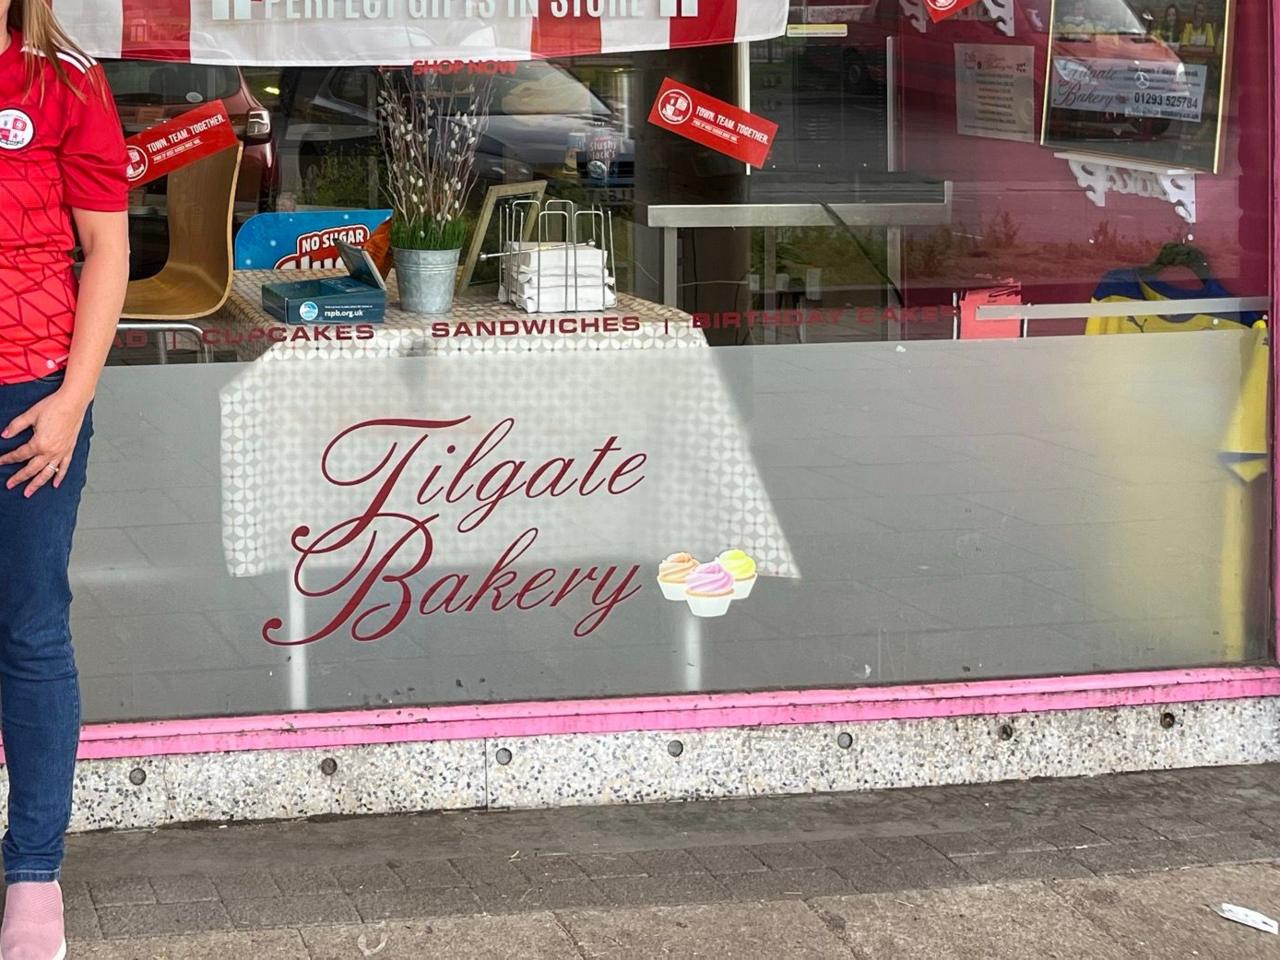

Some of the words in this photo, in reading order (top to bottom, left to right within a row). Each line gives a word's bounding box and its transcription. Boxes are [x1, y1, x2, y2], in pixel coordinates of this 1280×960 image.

[413, 60, 464, 76] SHOP
[468, 60, 517, 75] NOW
[1134, 93, 1163, 106] 01293
[1165, 95, 1198, 110] 525784
[168, 129, 191, 144] TEAM.
[302, 237, 319, 253] NO
[324, 309, 364, 318] rspb.org.uk
[202, 324, 375, 345] CUPCAKES
[431, 316, 640, 339] SANDWICHES
[692, 309, 844, 328] BIRTHDAY
[856, 305, 958, 323] CAKES
[291, 415, 647, 553] Tilgate
[262, 513, 642, 646] Bakery
